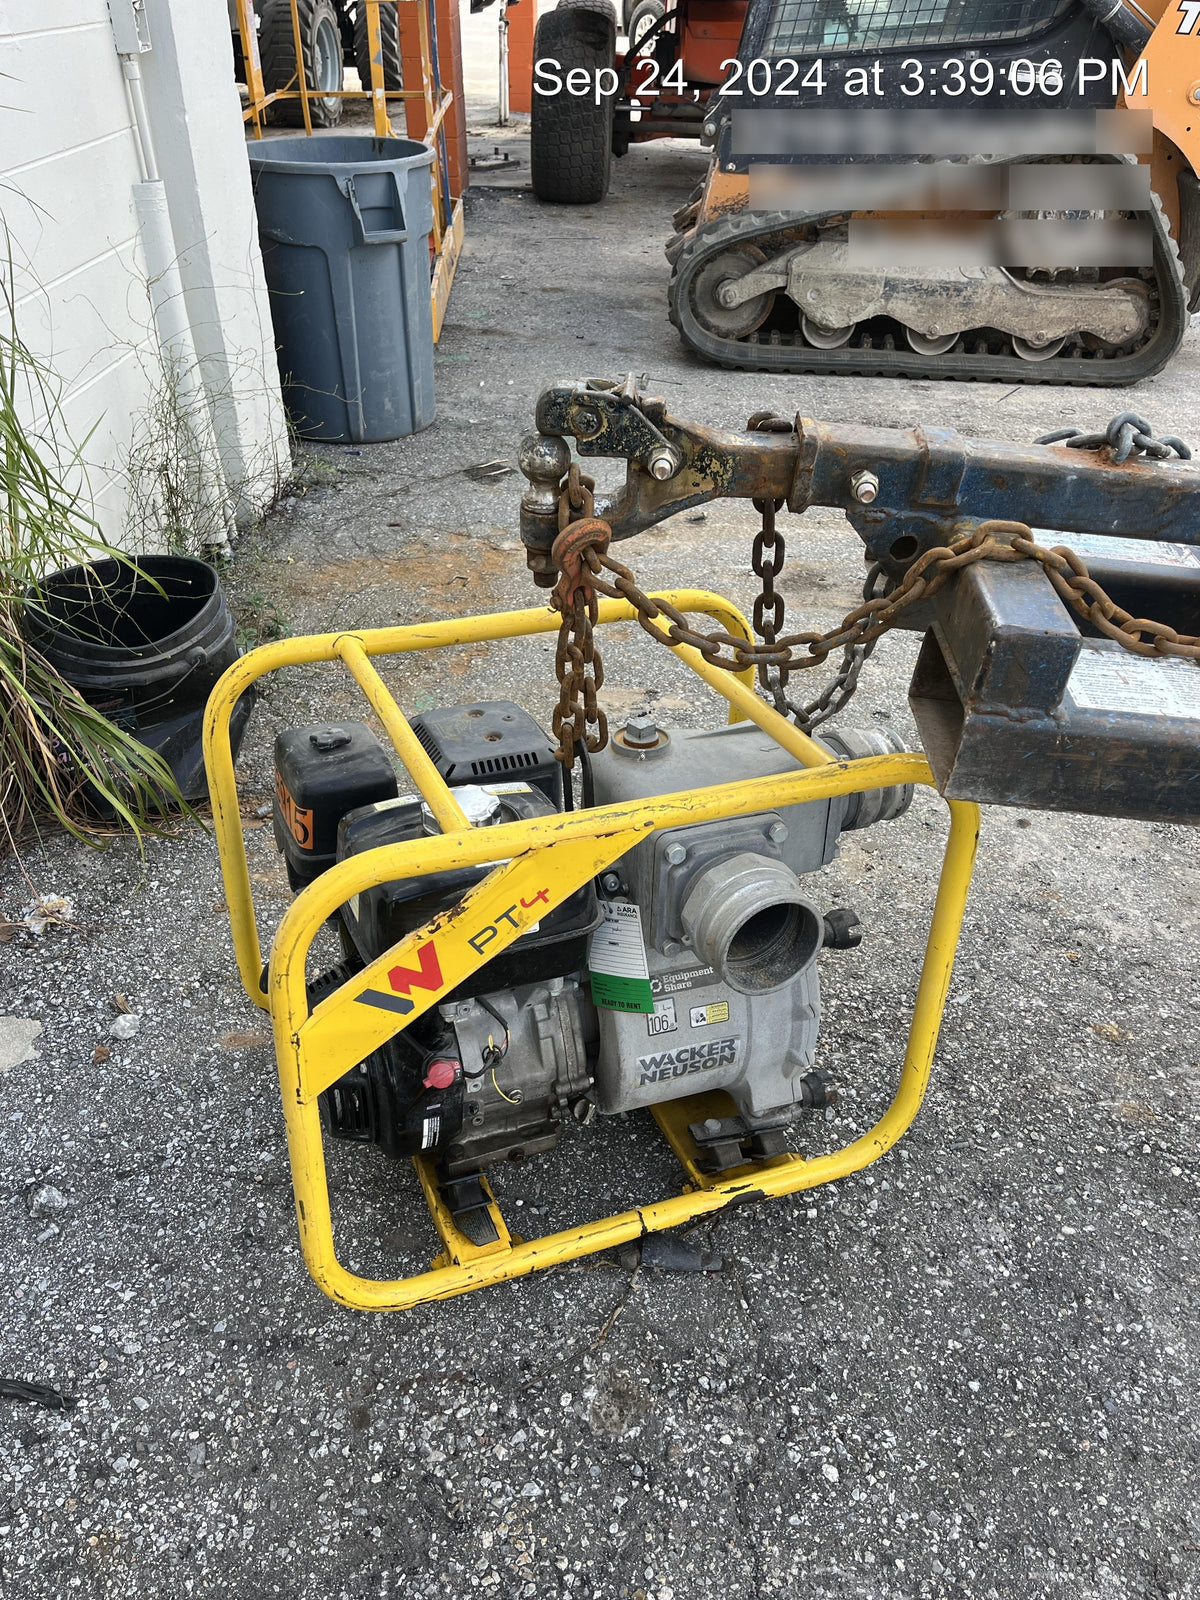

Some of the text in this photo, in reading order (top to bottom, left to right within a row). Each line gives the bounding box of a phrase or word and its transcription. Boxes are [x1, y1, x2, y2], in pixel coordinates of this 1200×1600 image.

[1175, 0, 1200, 36] T
[468, 888, 550, 956] PT4
[662, 966, 714, 984] Equipment
[664, 980, 692, 993] Share
[601, 998, 618, 1007] READY
[626, 1002, 641, 1010] RENT
[649, 1014, 669, 1034] 106
[639, 1039, 737, 1072] WACKER
[639, 1052, 736, 1086] NEUSON
